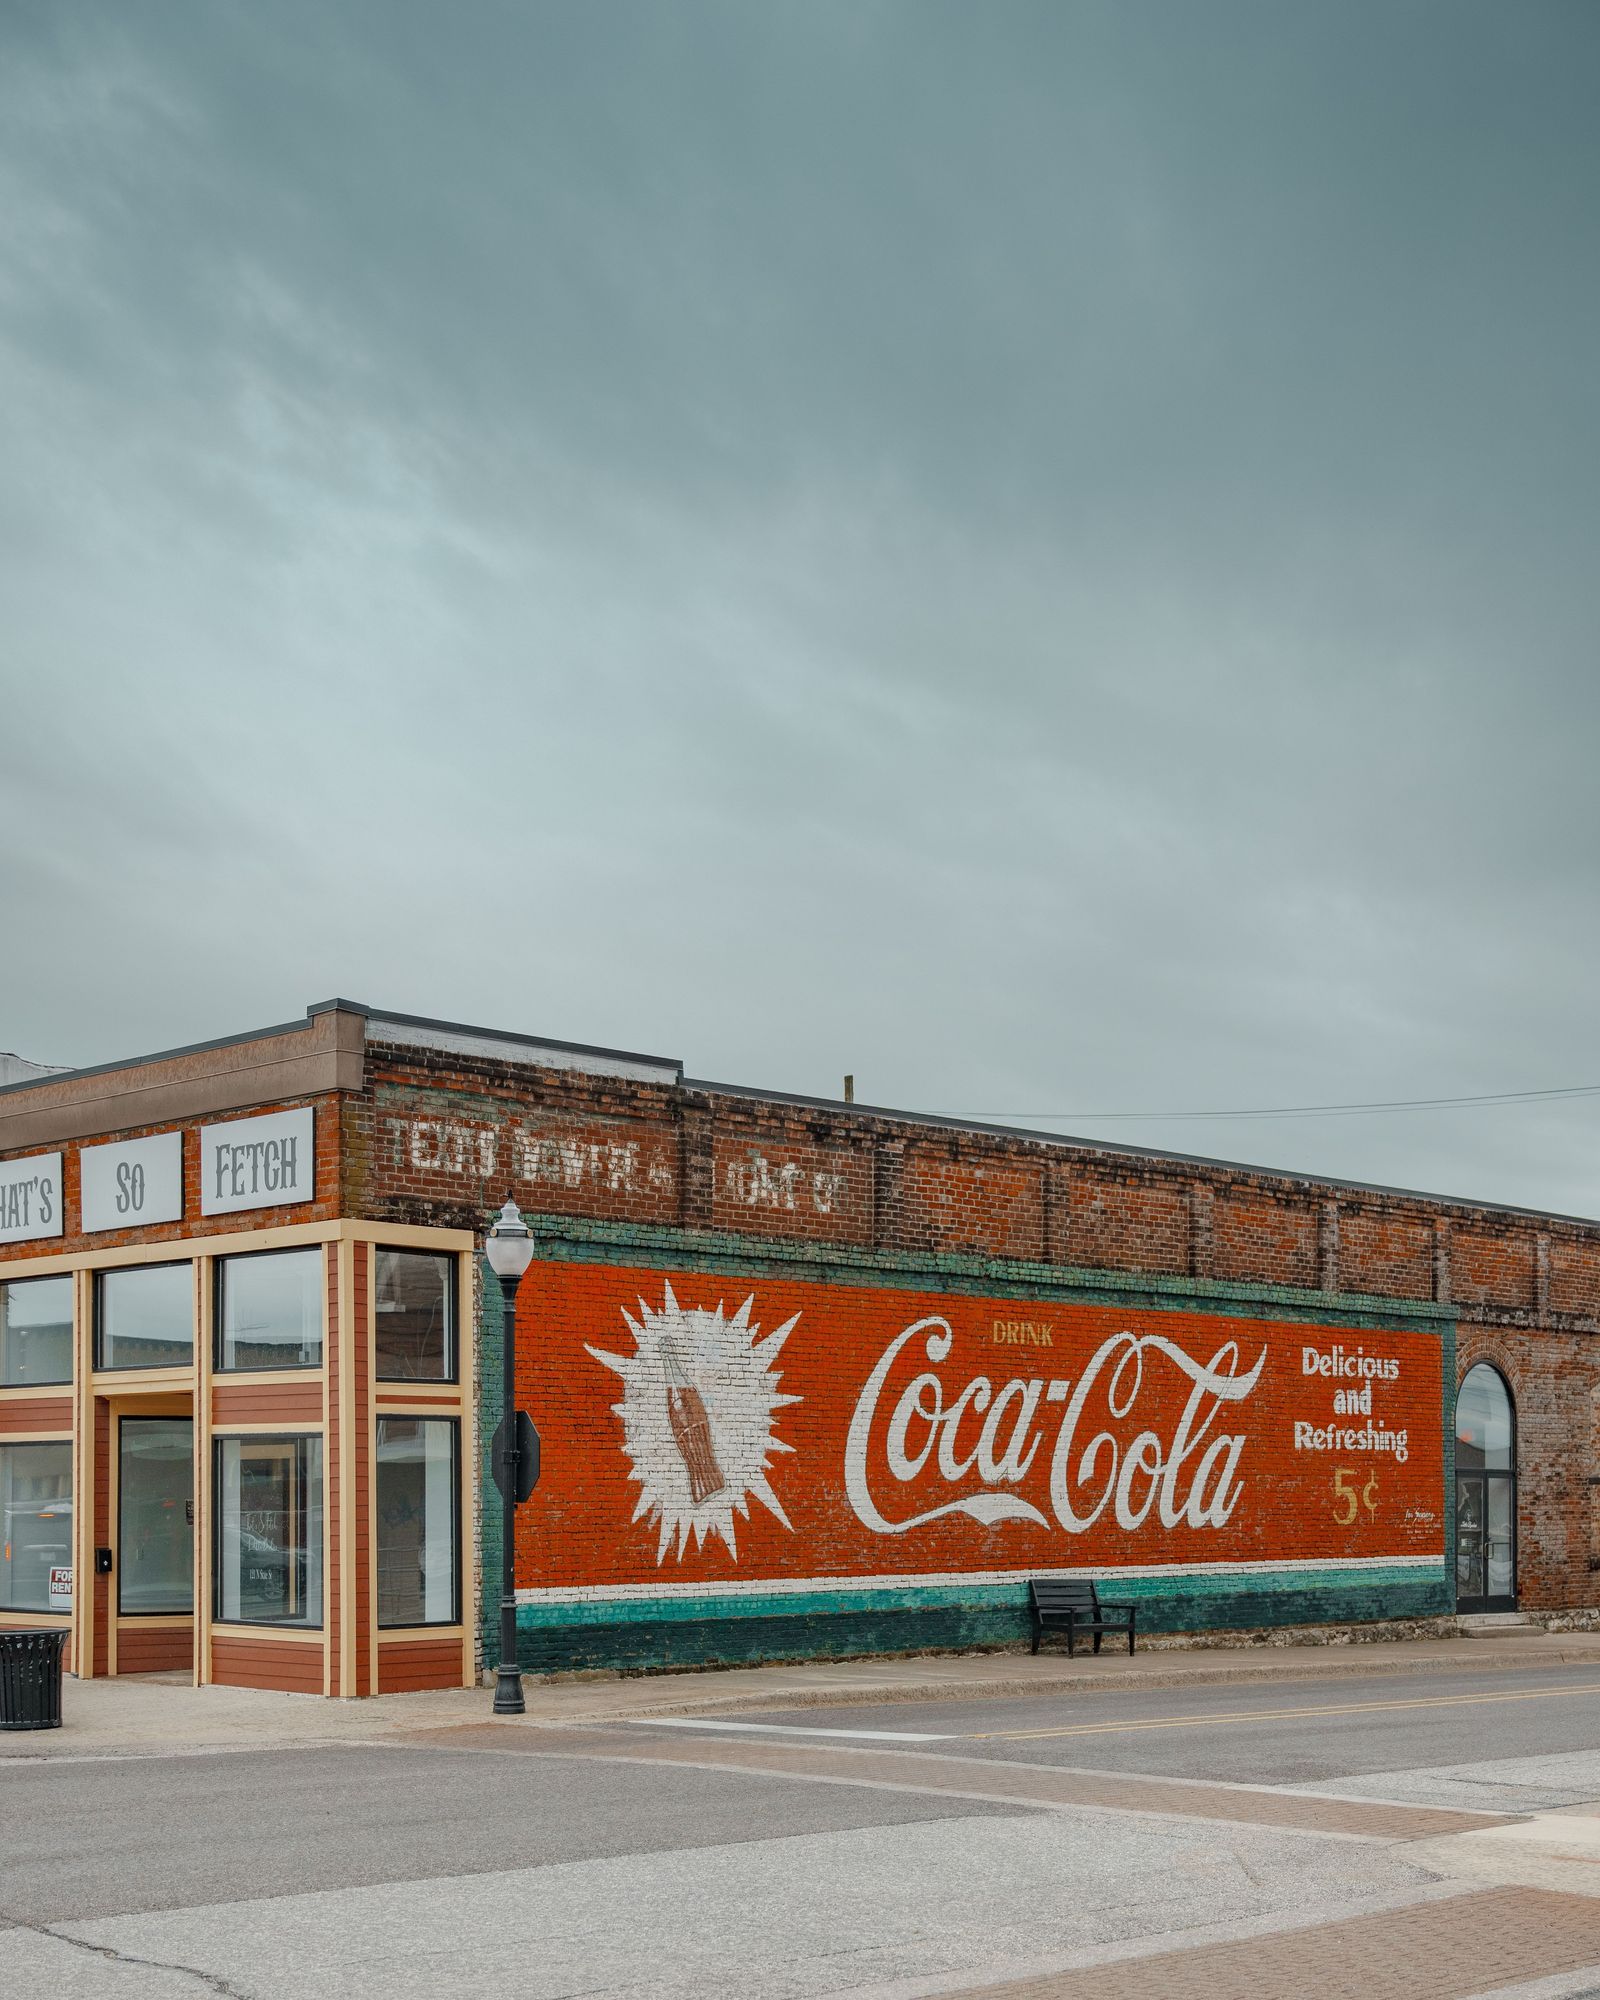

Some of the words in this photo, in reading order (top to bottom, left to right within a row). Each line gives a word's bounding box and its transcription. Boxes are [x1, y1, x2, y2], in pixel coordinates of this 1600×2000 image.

[115, 1162, 145, 1213] SO
[215, 1136, 298, 1199] FETCH
[993, 1320, 1054, 1347] DRINK
[1302, 1345, 1400, 1380] Delicious
[1333, 1379, 1372, 1415] and
[844, 1316, 1268, 1534] Coca-Cola
[1294, 1419, 1409, 1463] Refreshing
[1332, 1468, 1379, 1526] 5¢
[51, 1582, 73, 1594] REN
